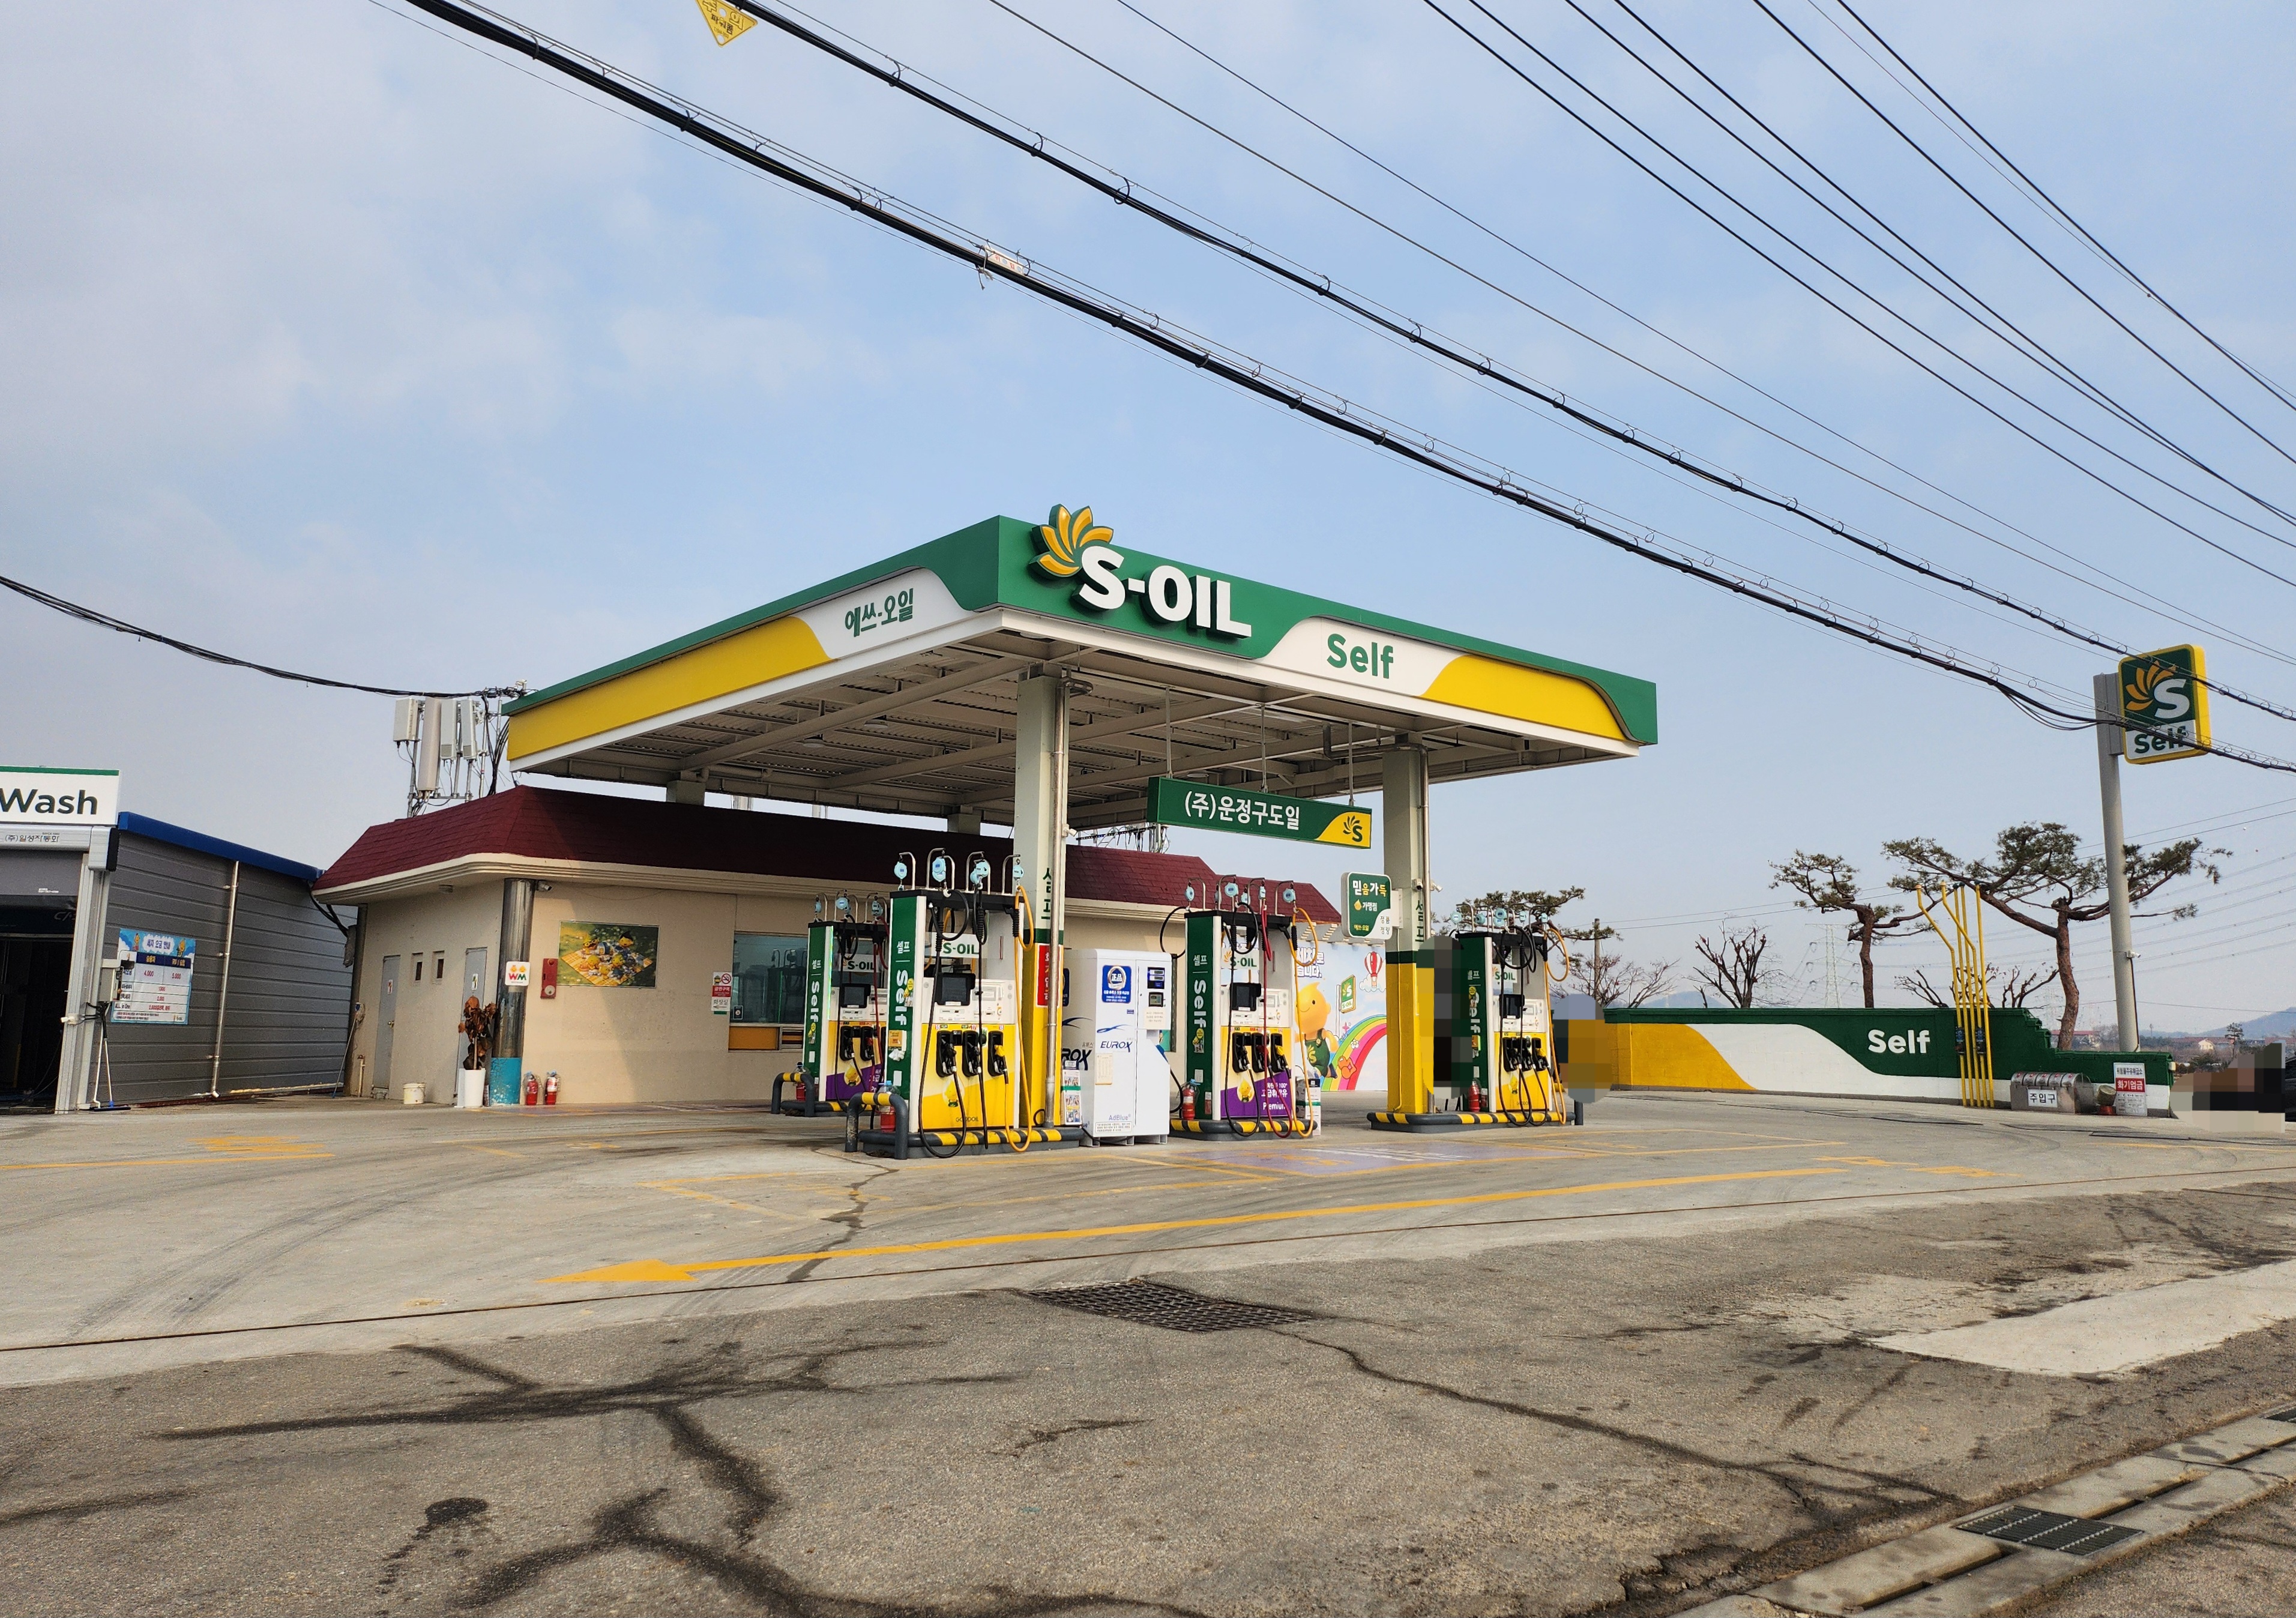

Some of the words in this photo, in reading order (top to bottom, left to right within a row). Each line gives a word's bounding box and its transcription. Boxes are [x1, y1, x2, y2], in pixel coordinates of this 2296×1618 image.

[1079, 545, 1252, 638] S-OIL
[1327, 633, 1394, 680] Self
[2134, 726, 2186, 753] Self
[0, 788, 98, 815] Wash
[1185, 791, 1300, 830] (주)운정구도일
[1352, 880, 1387, 898] 믿음가득
[1362, 902, 1378, 911] 가맹점
[896, 940, 911, 954] 셀프
[942, 942, 980, 955] S-OIL
[848, 960, 875, 970] S-OIL
[1193, 955, 1208, 966] 셀프
[1229, 957, 1257, 967] S-OIL
[1495, 972, 1516, 980] SOIL
[810, 980, 820, 1023] Self
[895, 970, 908, 1025] Self
[1194, 979, 1207, 1028] Self
[1100, 1041, 1133, 1053] EUROX
[1868, 1029, 1930, 1054] Self
[2117, 1080, 2143, 1090] 화기엄금
[2029, 1093, 2055, 1103] 주입구
[1262, 1102, 1286, 1110] Pemiu
